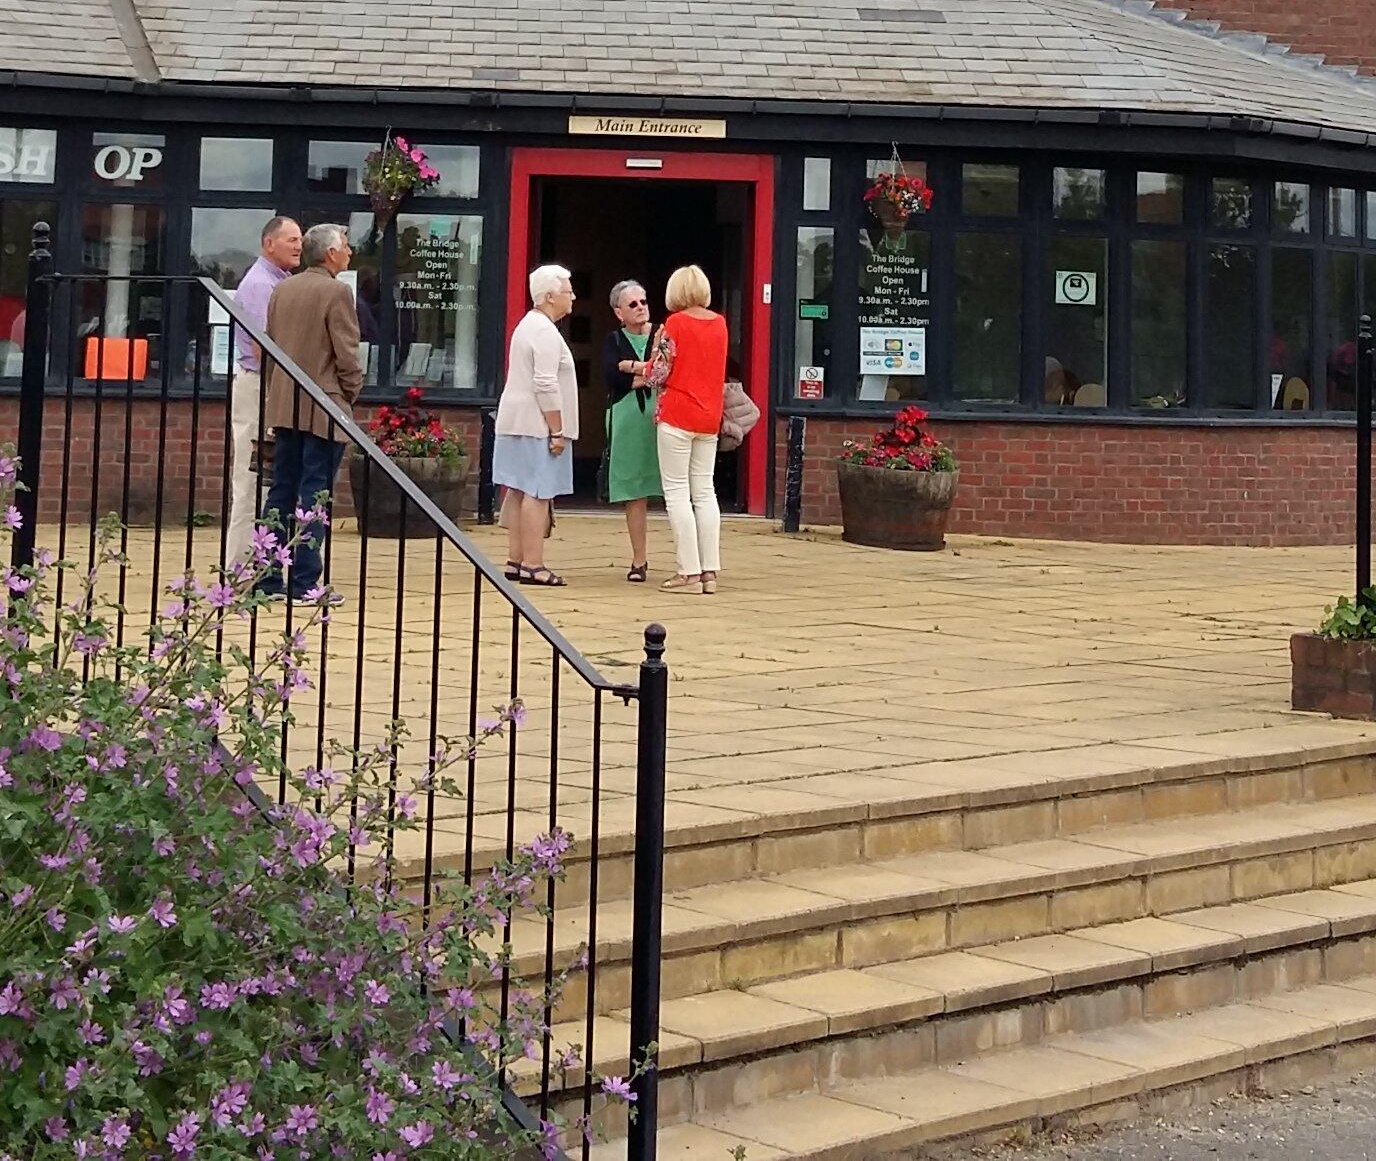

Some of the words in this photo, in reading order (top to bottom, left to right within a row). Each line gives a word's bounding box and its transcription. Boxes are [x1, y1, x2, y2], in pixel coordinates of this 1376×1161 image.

[594, 118, 635, 133] Main
[638, 120, 703, 134] Entrance
[416, 238, 431, 247] The
[432, 239, 459, 249] Bridge
[410, 249, 436, 258] Coffee
[438, 250, 464, 259] House
[872, 254, 887, 263] The
[888, 254, 915, 265] Bridge
[425, 260, 448, 270] Open
[866, 265, 893, 274] Coffee
[894, 266, 920, 274] House
[882, 276, 904, 285] Open
[874, 286, 892, 295] Mon
[898, 287, 910, 295] Fri
[884, 307, 898, 315] Sat
